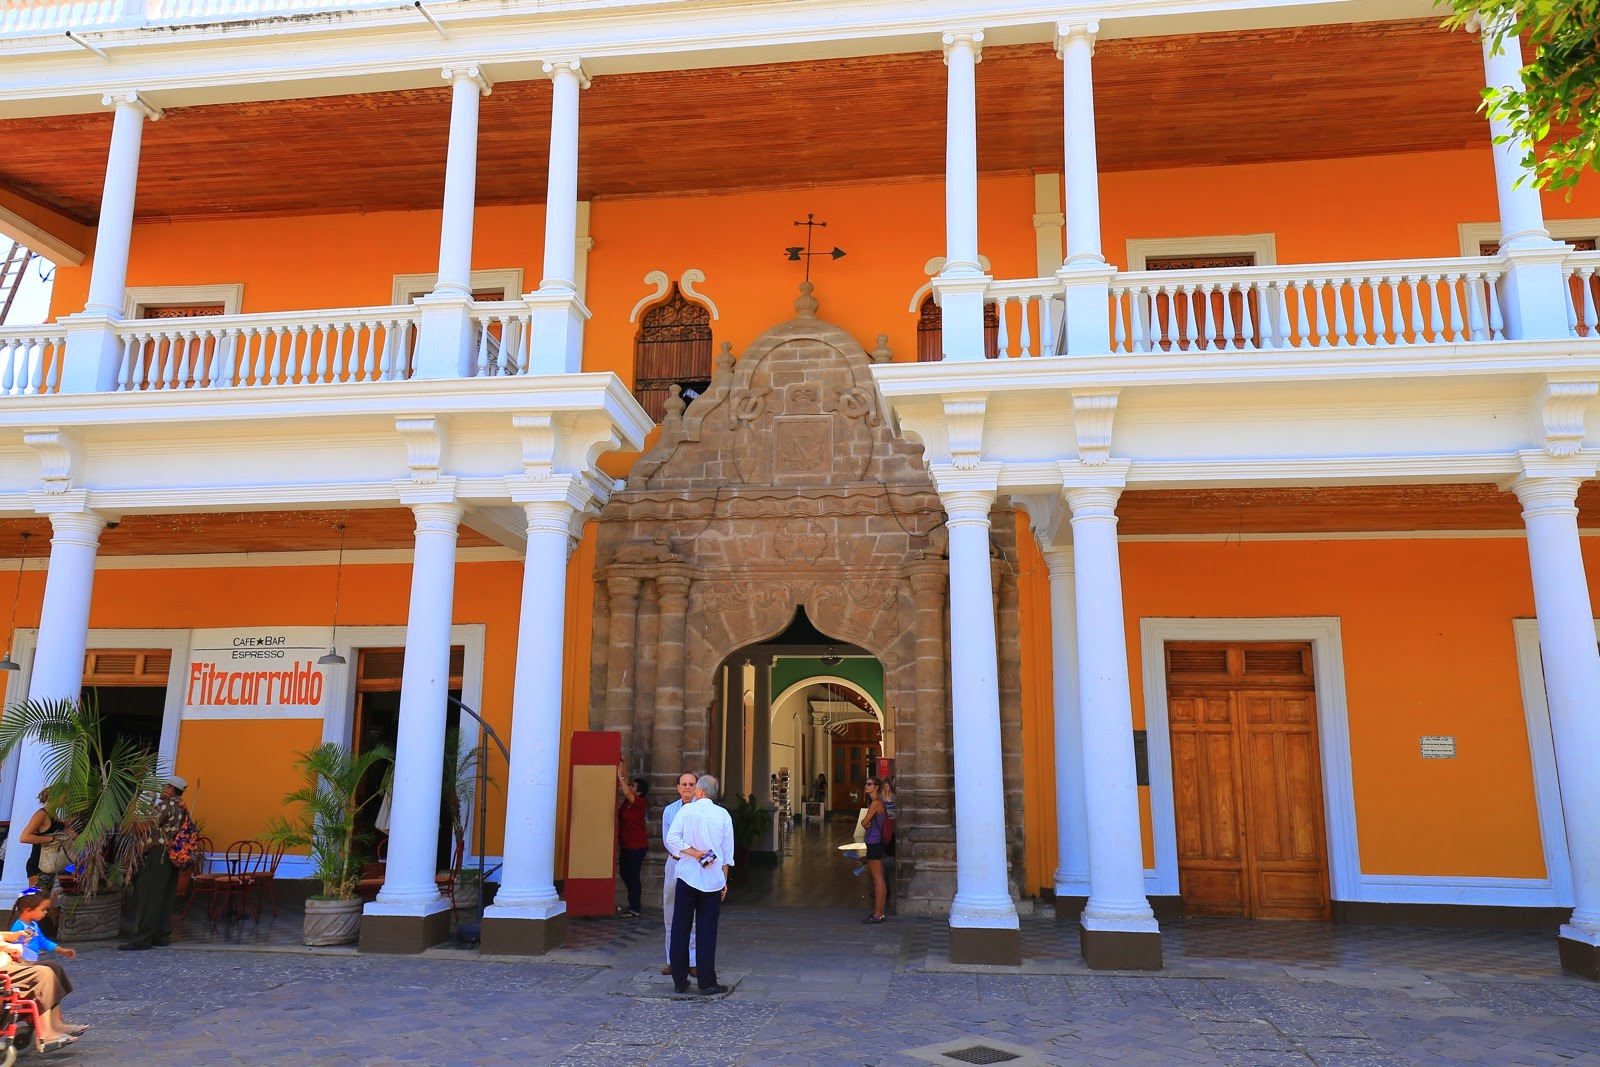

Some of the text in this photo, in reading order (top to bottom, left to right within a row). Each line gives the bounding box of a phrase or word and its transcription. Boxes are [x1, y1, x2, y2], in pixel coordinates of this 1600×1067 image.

[233, 636, 286, 646] CAFE BAR
[232, 650, 285, 659] ESPRESSO
[186, 661, 323, 706] Fitzcarraldo
